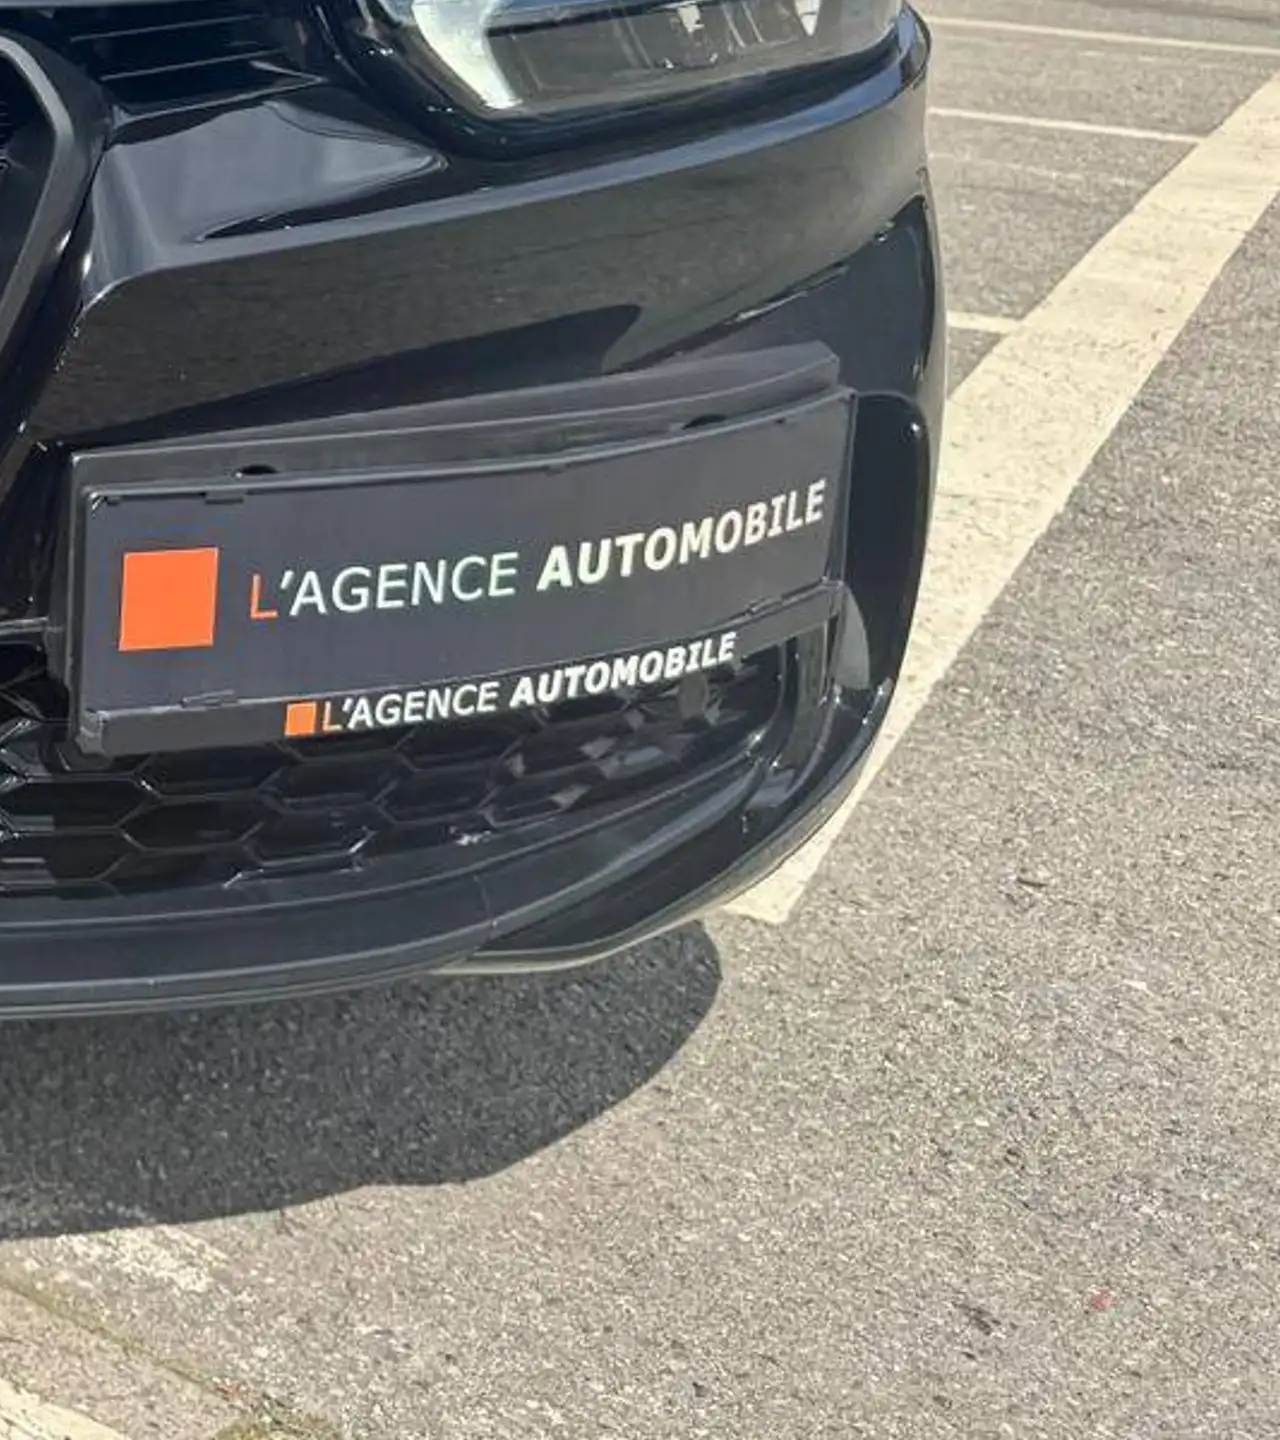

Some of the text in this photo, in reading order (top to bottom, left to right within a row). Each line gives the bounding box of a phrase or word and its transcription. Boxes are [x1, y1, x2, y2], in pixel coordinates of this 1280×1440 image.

[249, 478, 826, 620] L'AGENCE AUTOMOBILE
[322, 630, 737, 732] L'AGENCE AUTOMOBILE
